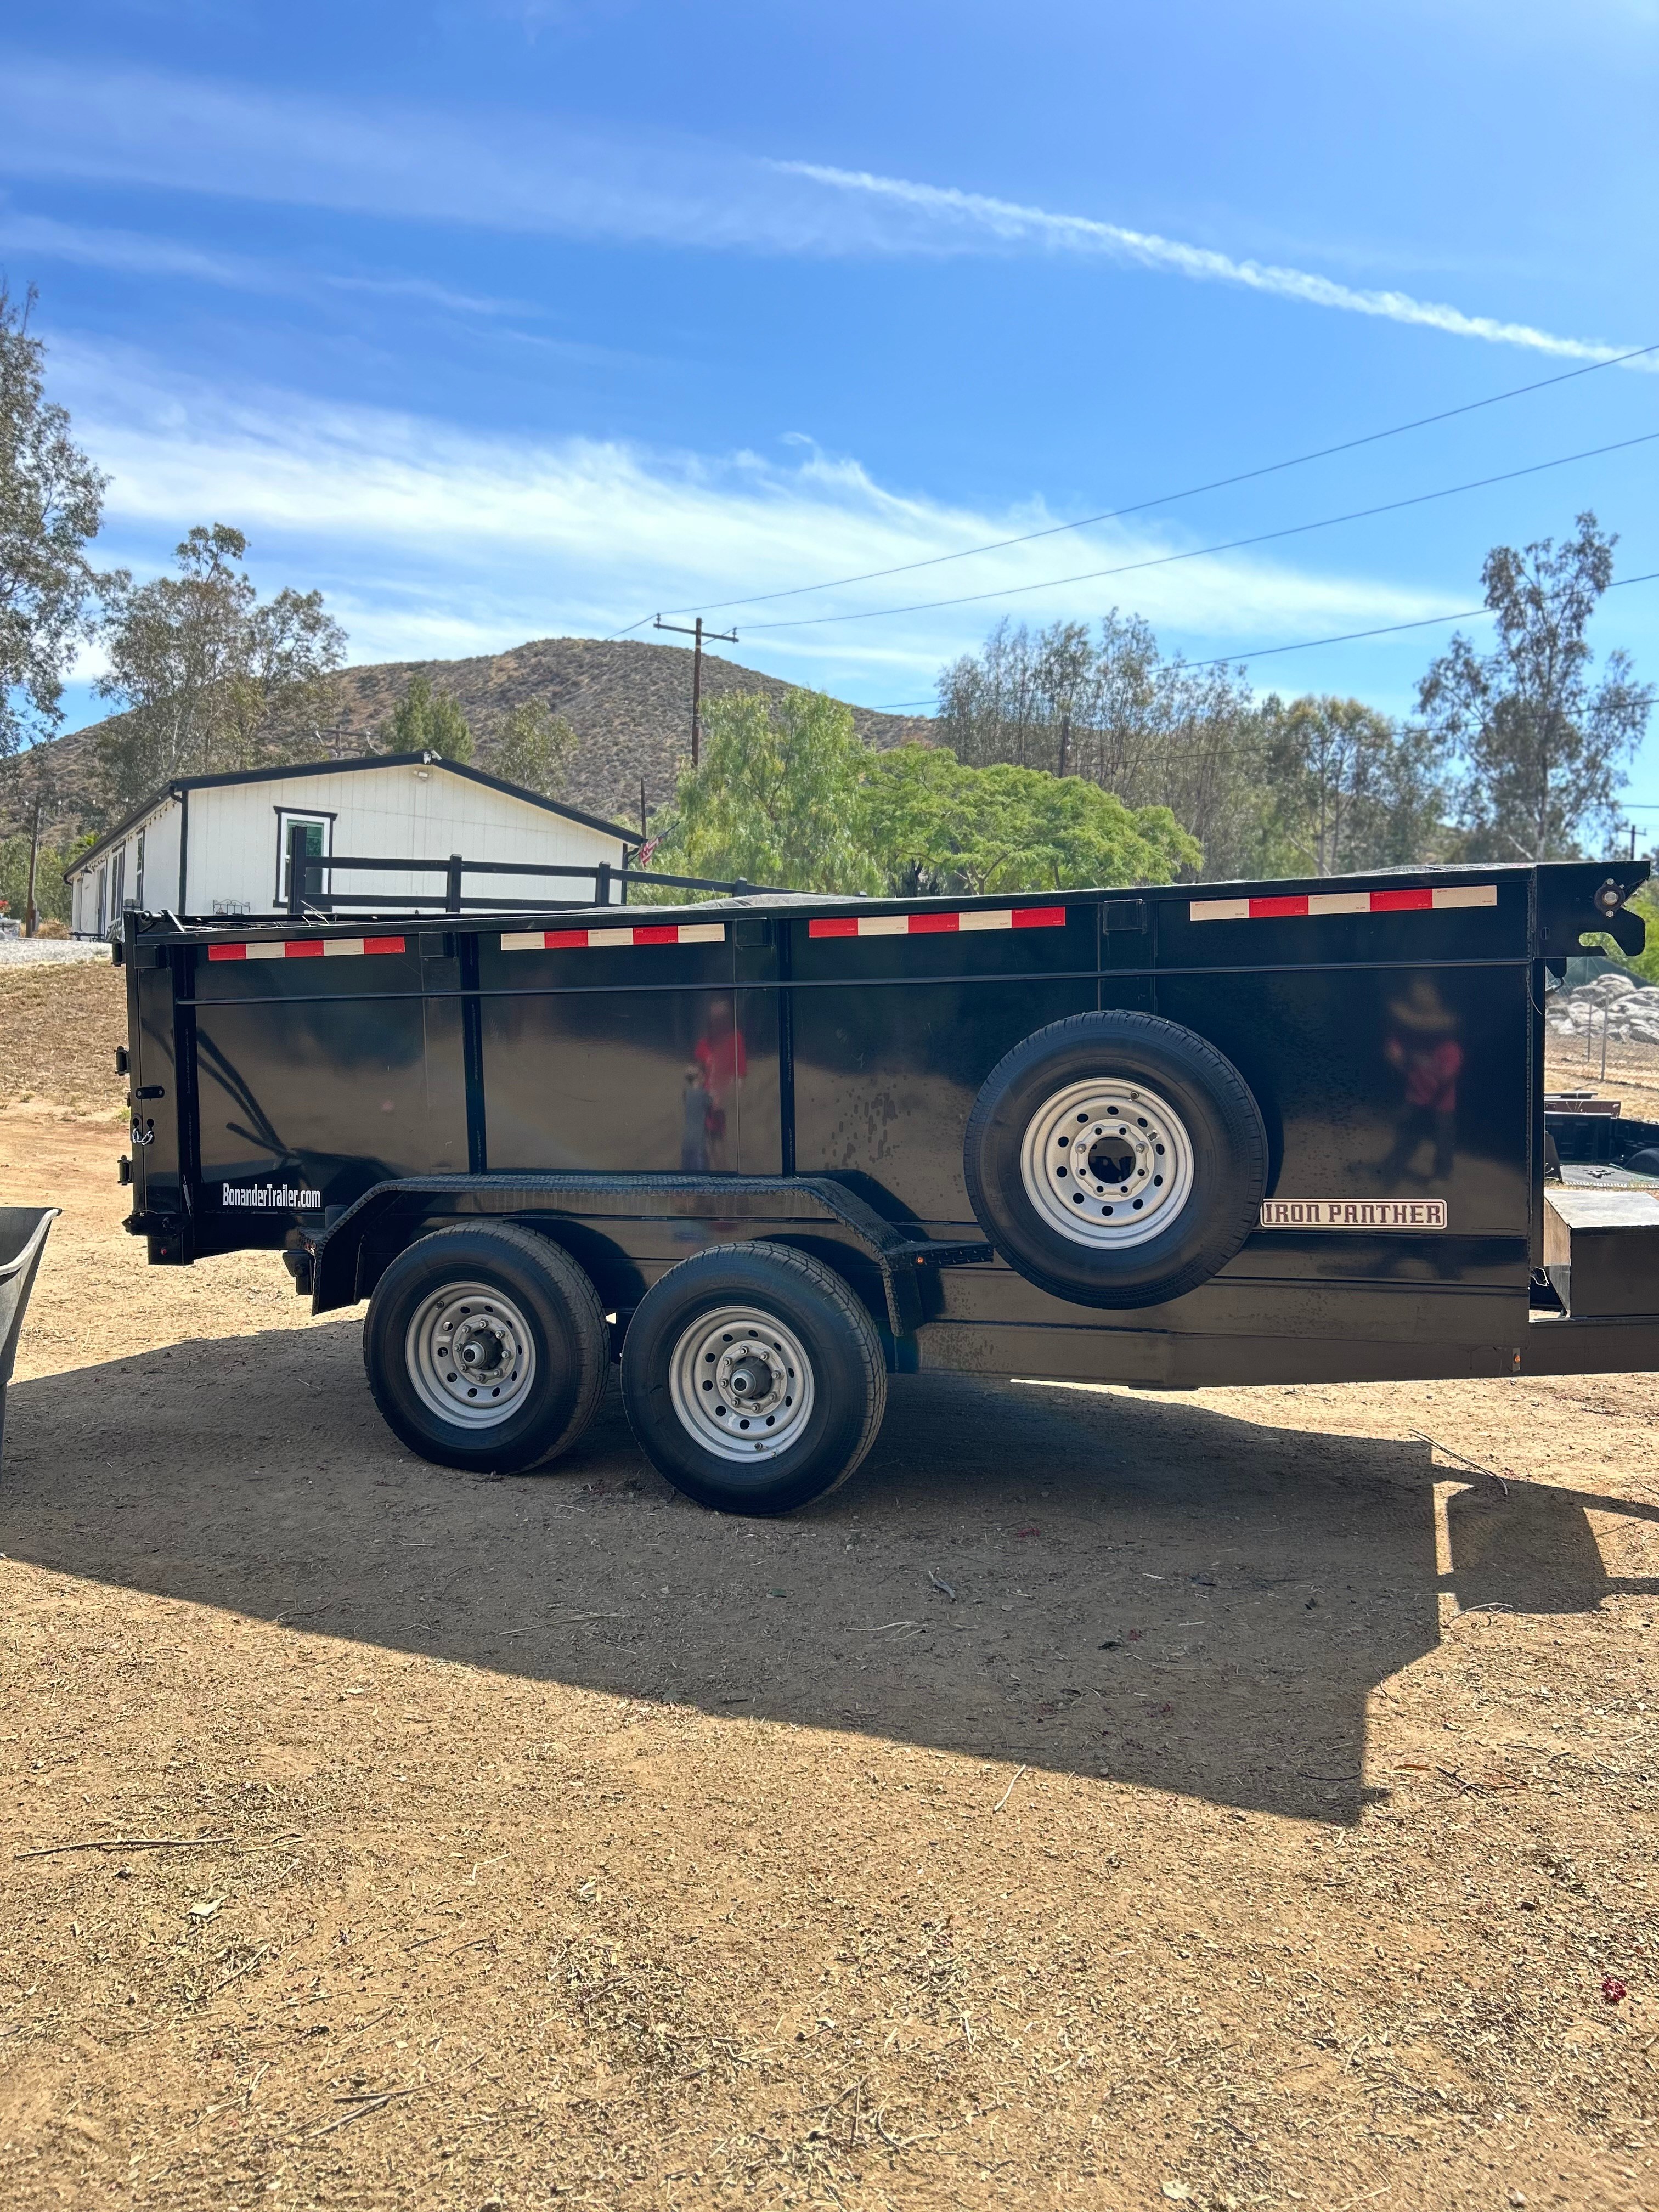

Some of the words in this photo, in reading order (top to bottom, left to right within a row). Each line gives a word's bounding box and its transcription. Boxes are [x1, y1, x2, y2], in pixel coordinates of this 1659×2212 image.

[223, 1183, 321, 1207] BonanderTrailer.com
[1266, 1204, 1321, 1222] IRON
[1328, 1204, 1441, 1224] PANTHER
